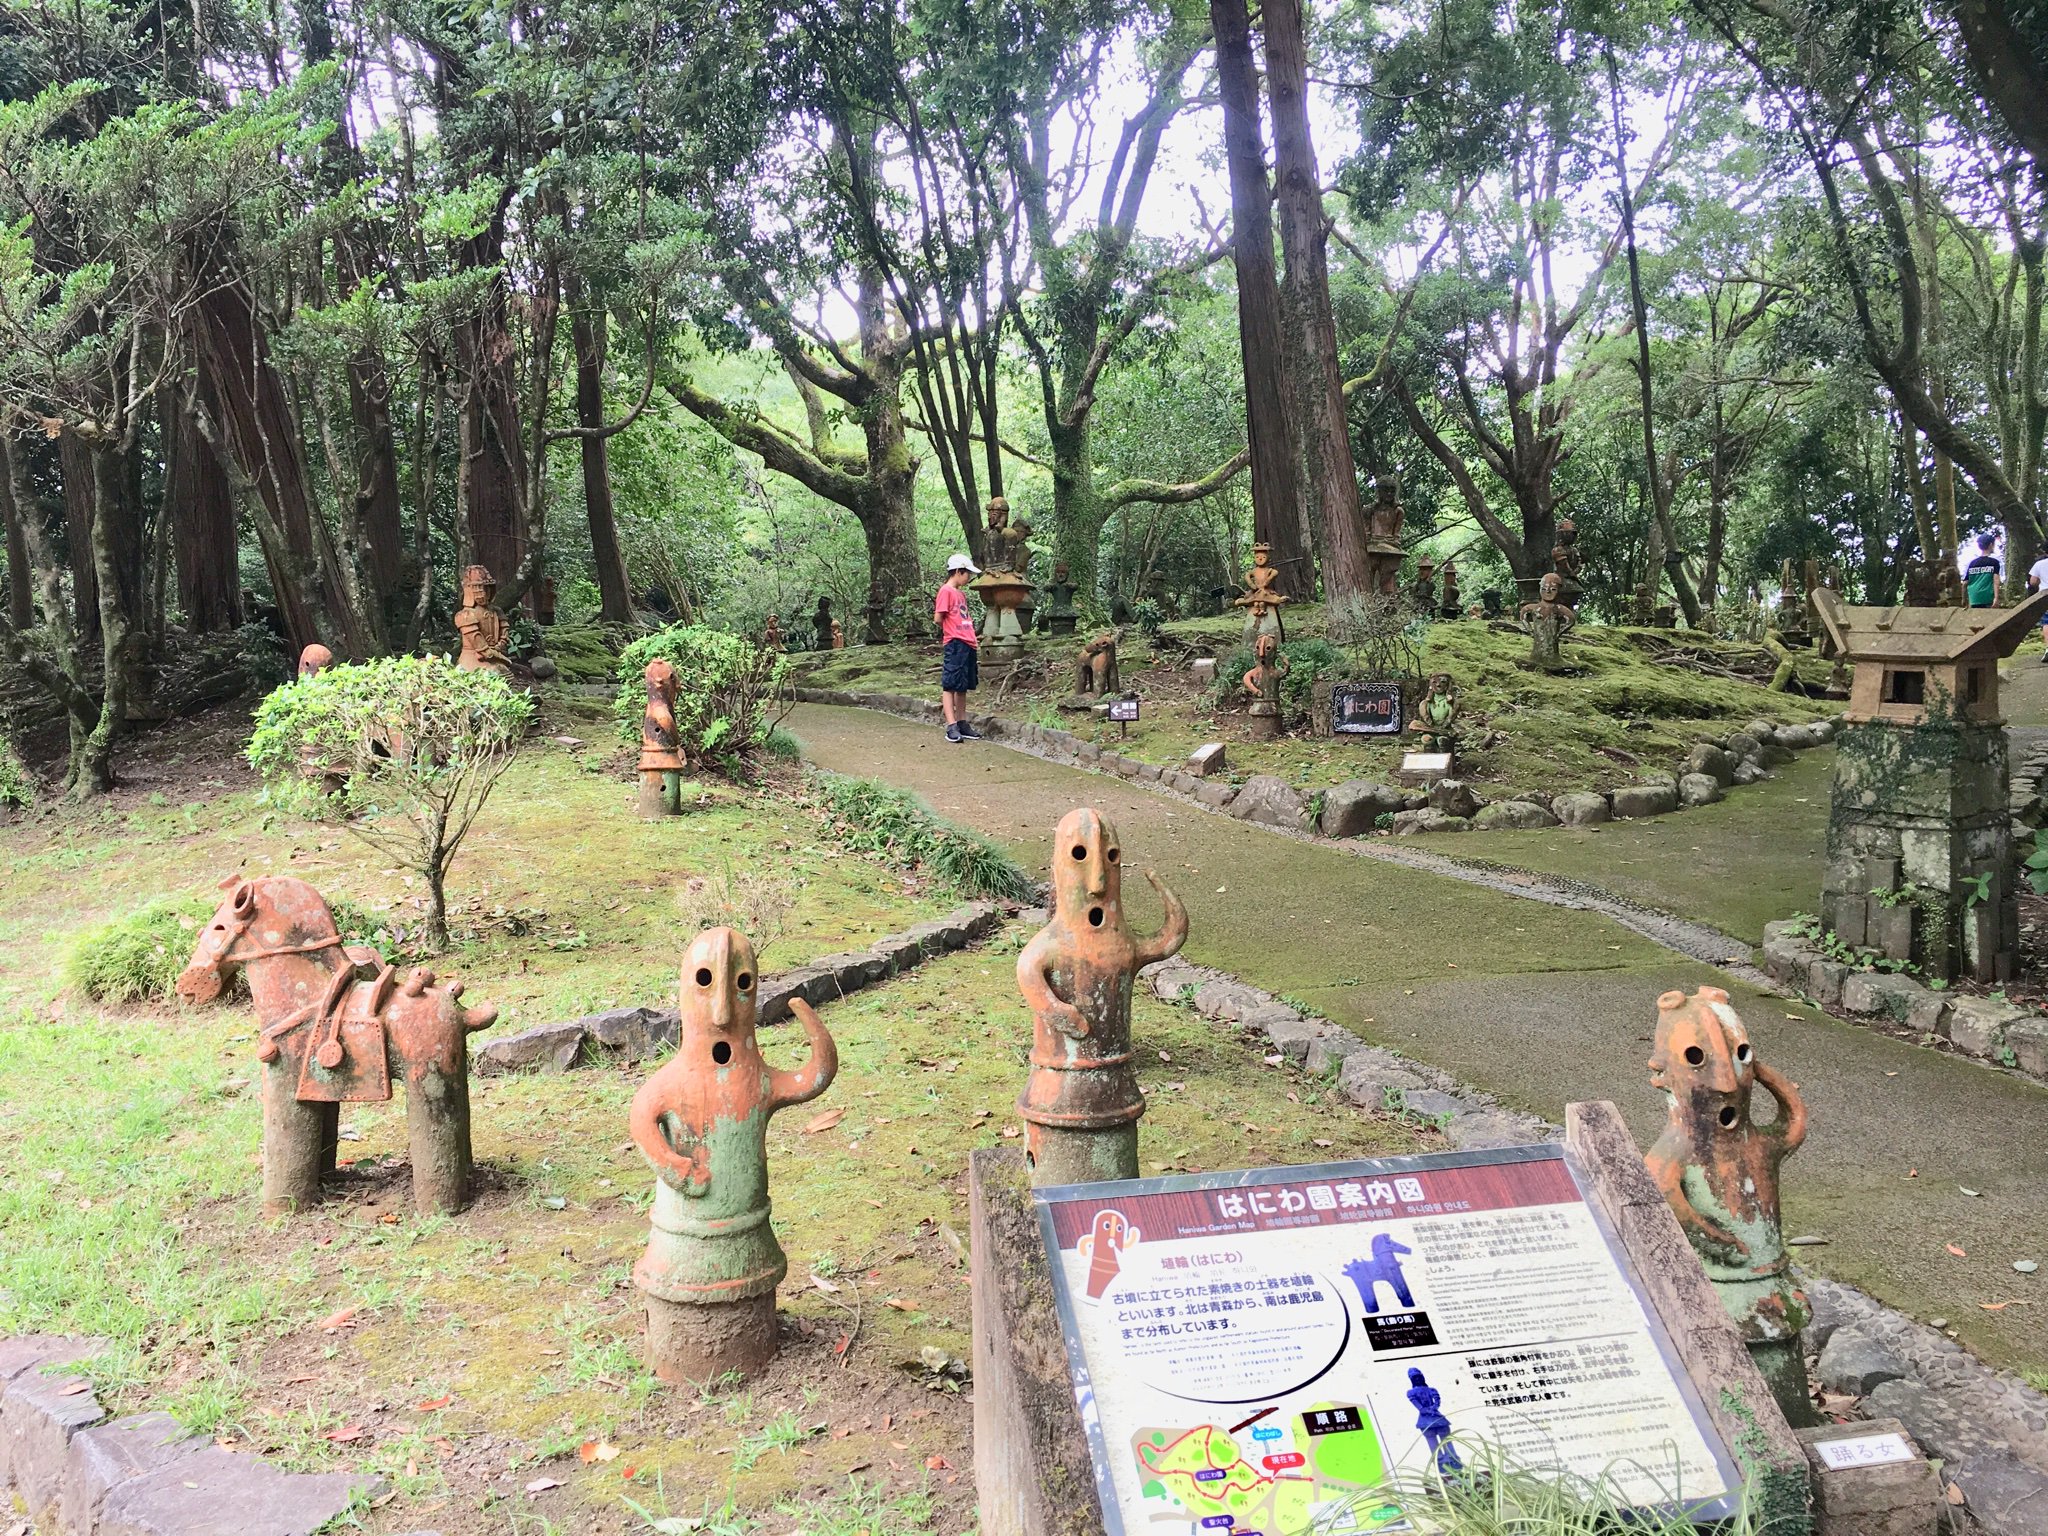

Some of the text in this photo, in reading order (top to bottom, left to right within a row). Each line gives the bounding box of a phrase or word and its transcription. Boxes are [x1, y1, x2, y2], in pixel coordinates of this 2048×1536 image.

[1218, 1178, 1425, 1218] はにわ園案内図
[1178, 1221, 1255, 1234] Haniwa Garden Map
[1112, 1275, 1315, 1305] 古墳に立てられた素焼きの土器を埴輪
[1118, 1290, 1324, 1322] といいます。北は青森から、南は鹿児島
[1121, 1317, 1237, 1340] まで分布しています。
[1315, 1410, 1348, 1425] 順路
[1271, 1455, 1297, 1465] 現在地
[1830, 1440, 1896, 1461] 踊る女
